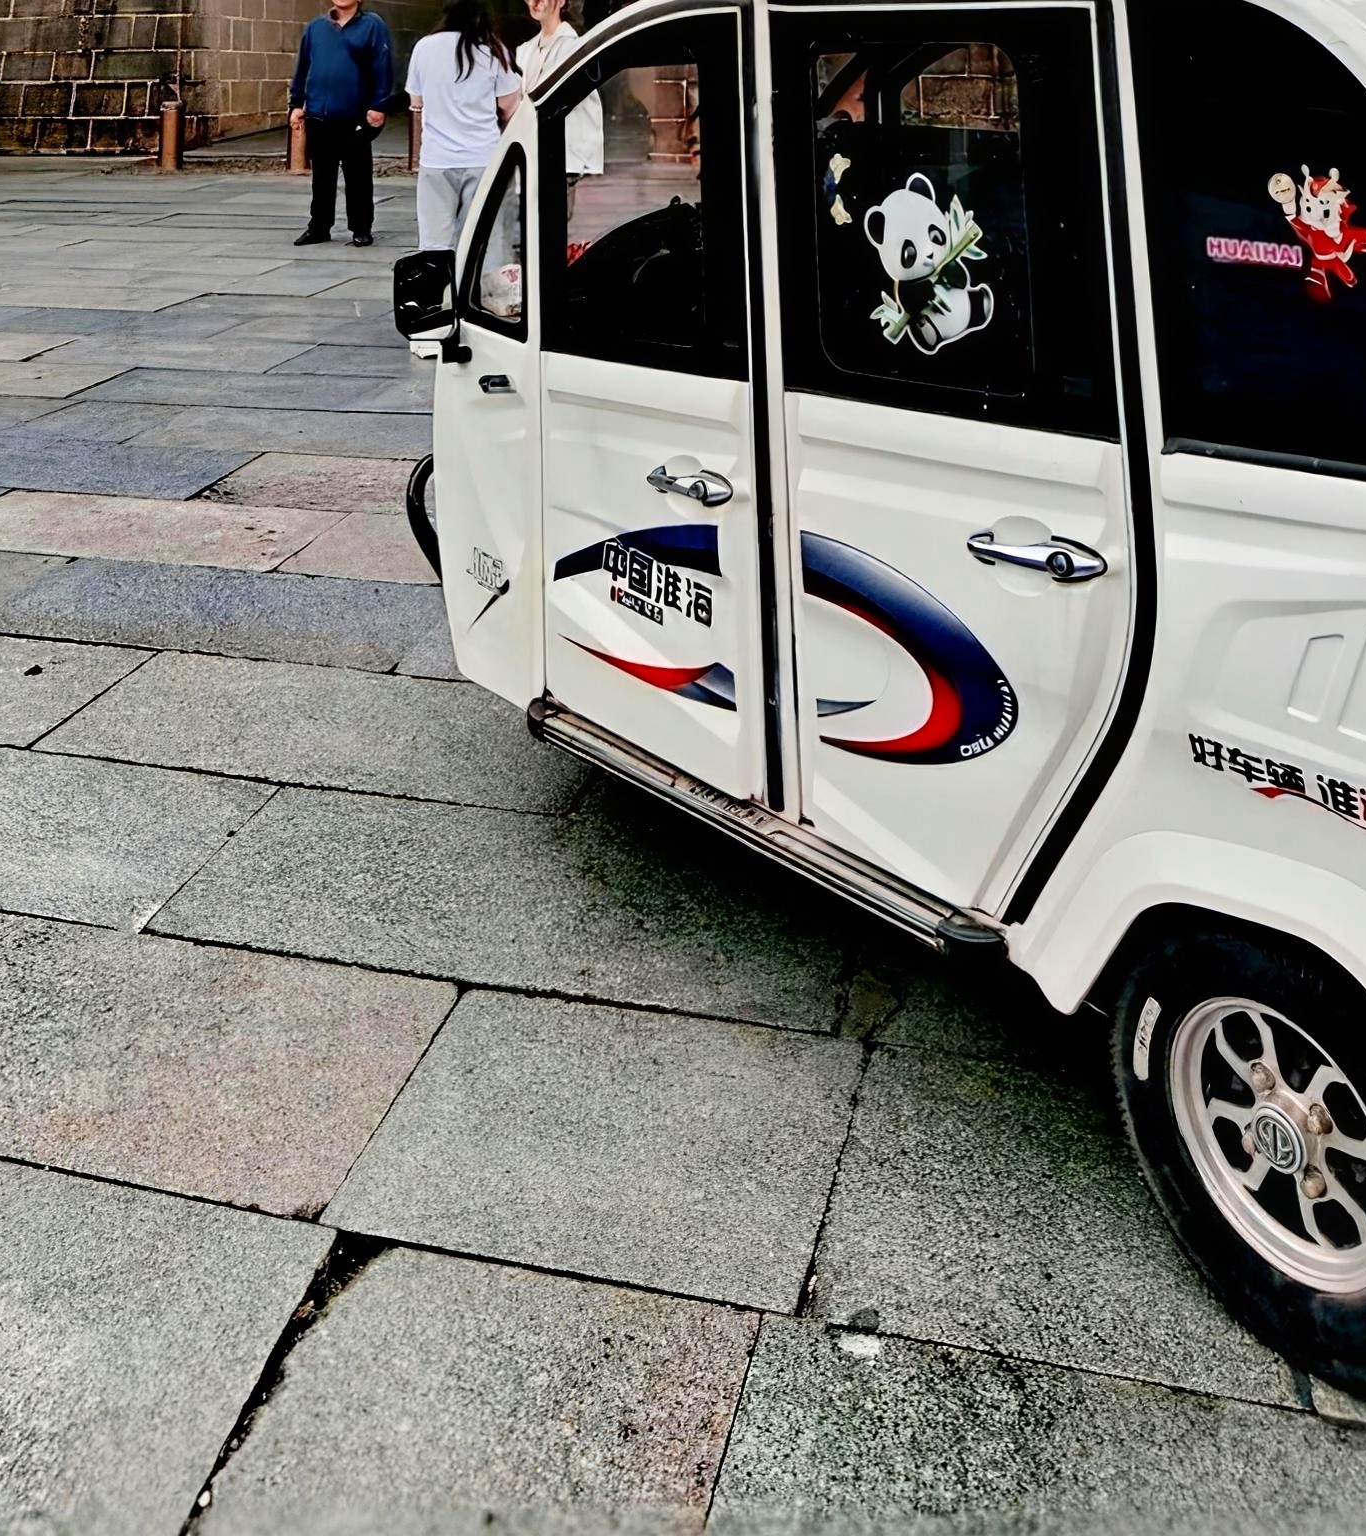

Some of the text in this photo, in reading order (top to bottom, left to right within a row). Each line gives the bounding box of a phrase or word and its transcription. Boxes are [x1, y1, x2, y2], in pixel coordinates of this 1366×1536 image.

[1206, 236, 1303, 268] HUAIHAI
[602, 542, 713, 628] 中国淮海
